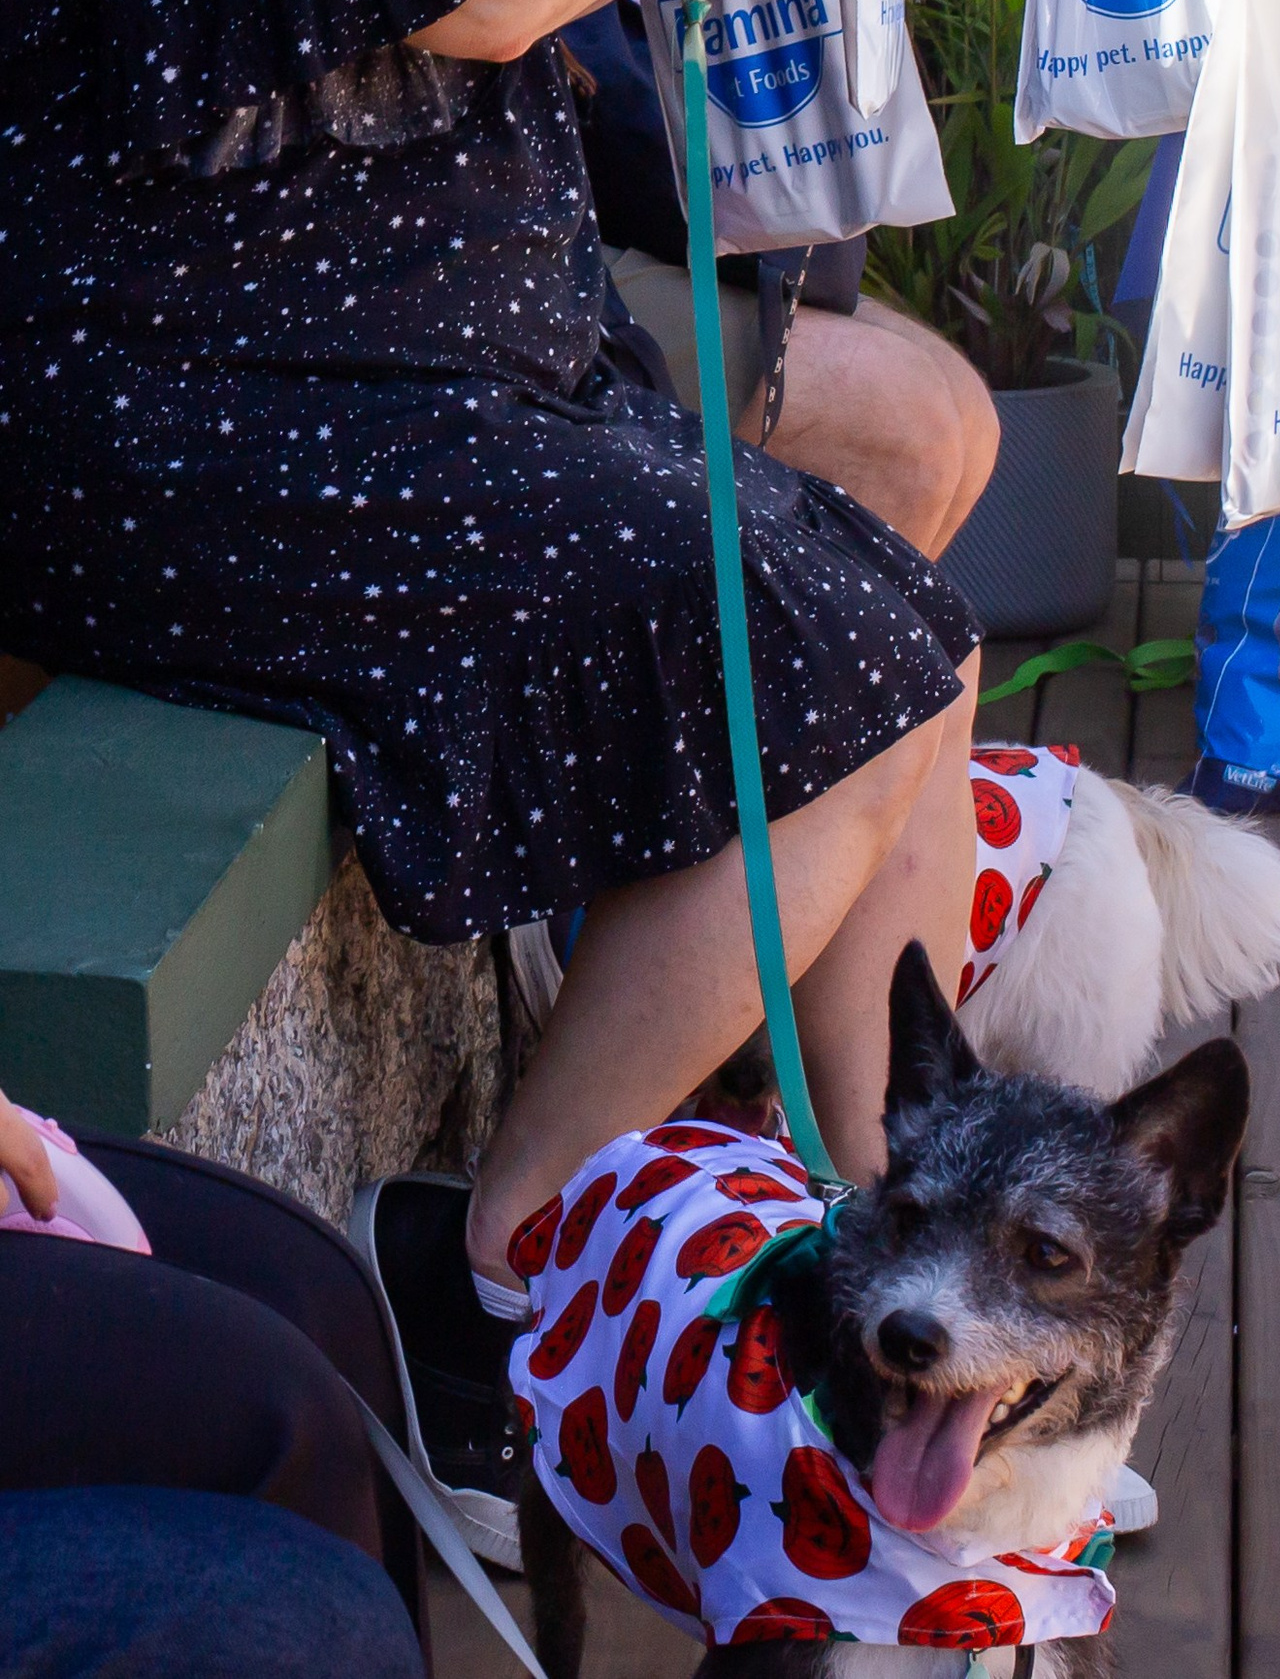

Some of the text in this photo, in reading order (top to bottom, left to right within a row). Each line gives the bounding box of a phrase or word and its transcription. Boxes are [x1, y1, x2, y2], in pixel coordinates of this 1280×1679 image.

[1096, 44, 1136, 72] pet.
[749, 59, 811, 94] Foods
[1226, 765, 1274, 793] VetLife
